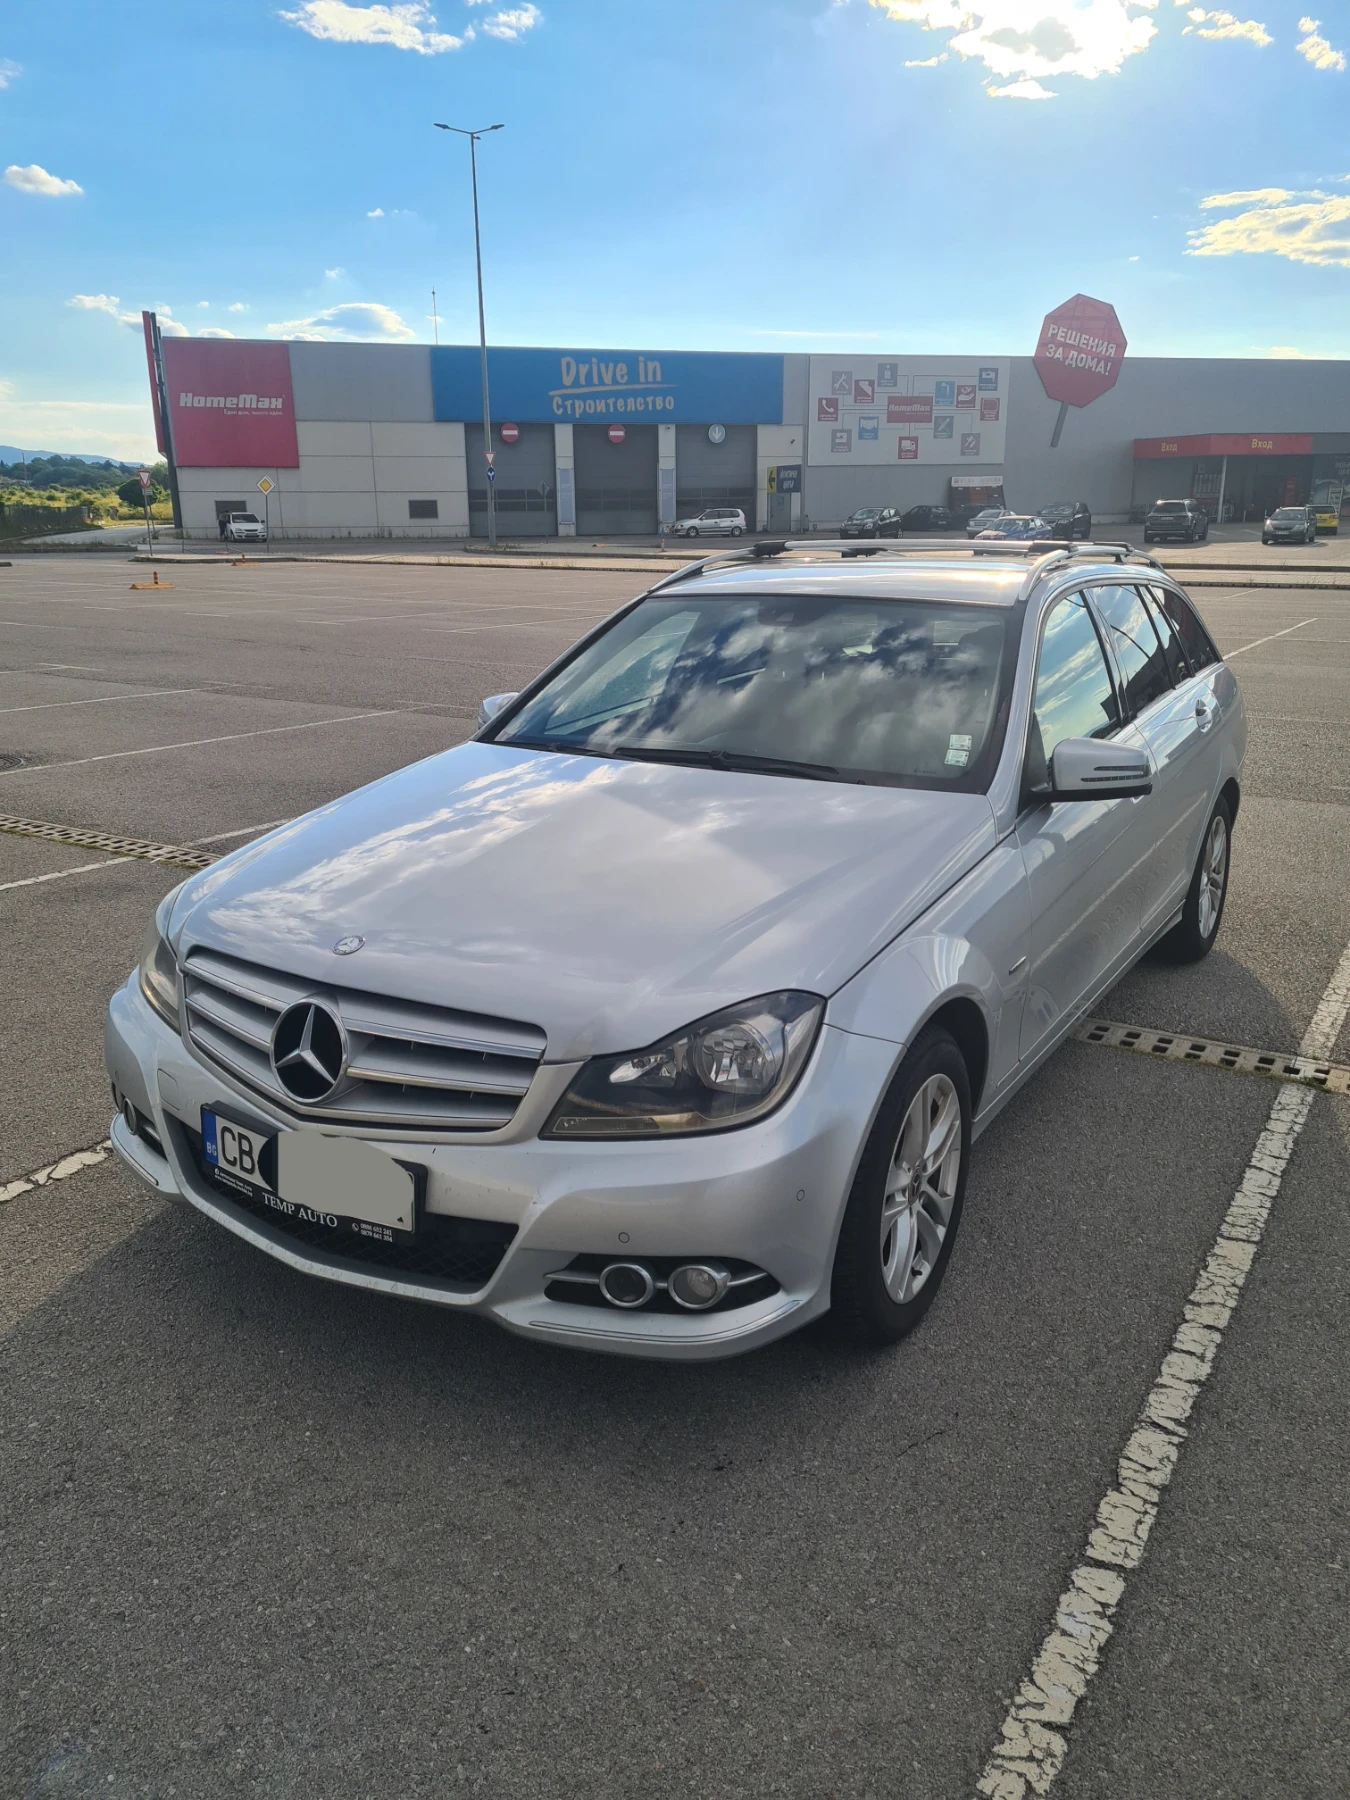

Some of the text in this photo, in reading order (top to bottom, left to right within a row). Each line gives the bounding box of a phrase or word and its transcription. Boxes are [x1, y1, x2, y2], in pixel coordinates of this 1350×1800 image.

[1047, 324, 1117, 358] РЕШЕНИЯ
[561, 355, 662, 387] Drive in
[1045, 343, 1112, 376] ЗА ДОМА!
[179, 392, 283, 409] HomeMax
[552, 395, 675, 418] Строителство
[1160, 442, 1178, 452] Вход
[1251, 438, 1273, 449] Вход
[206, 1141, 217, 1156] BG
[220, 1125, 256, 1175] CB
[261, 1191, 338, 1228] TEMP AUTO
